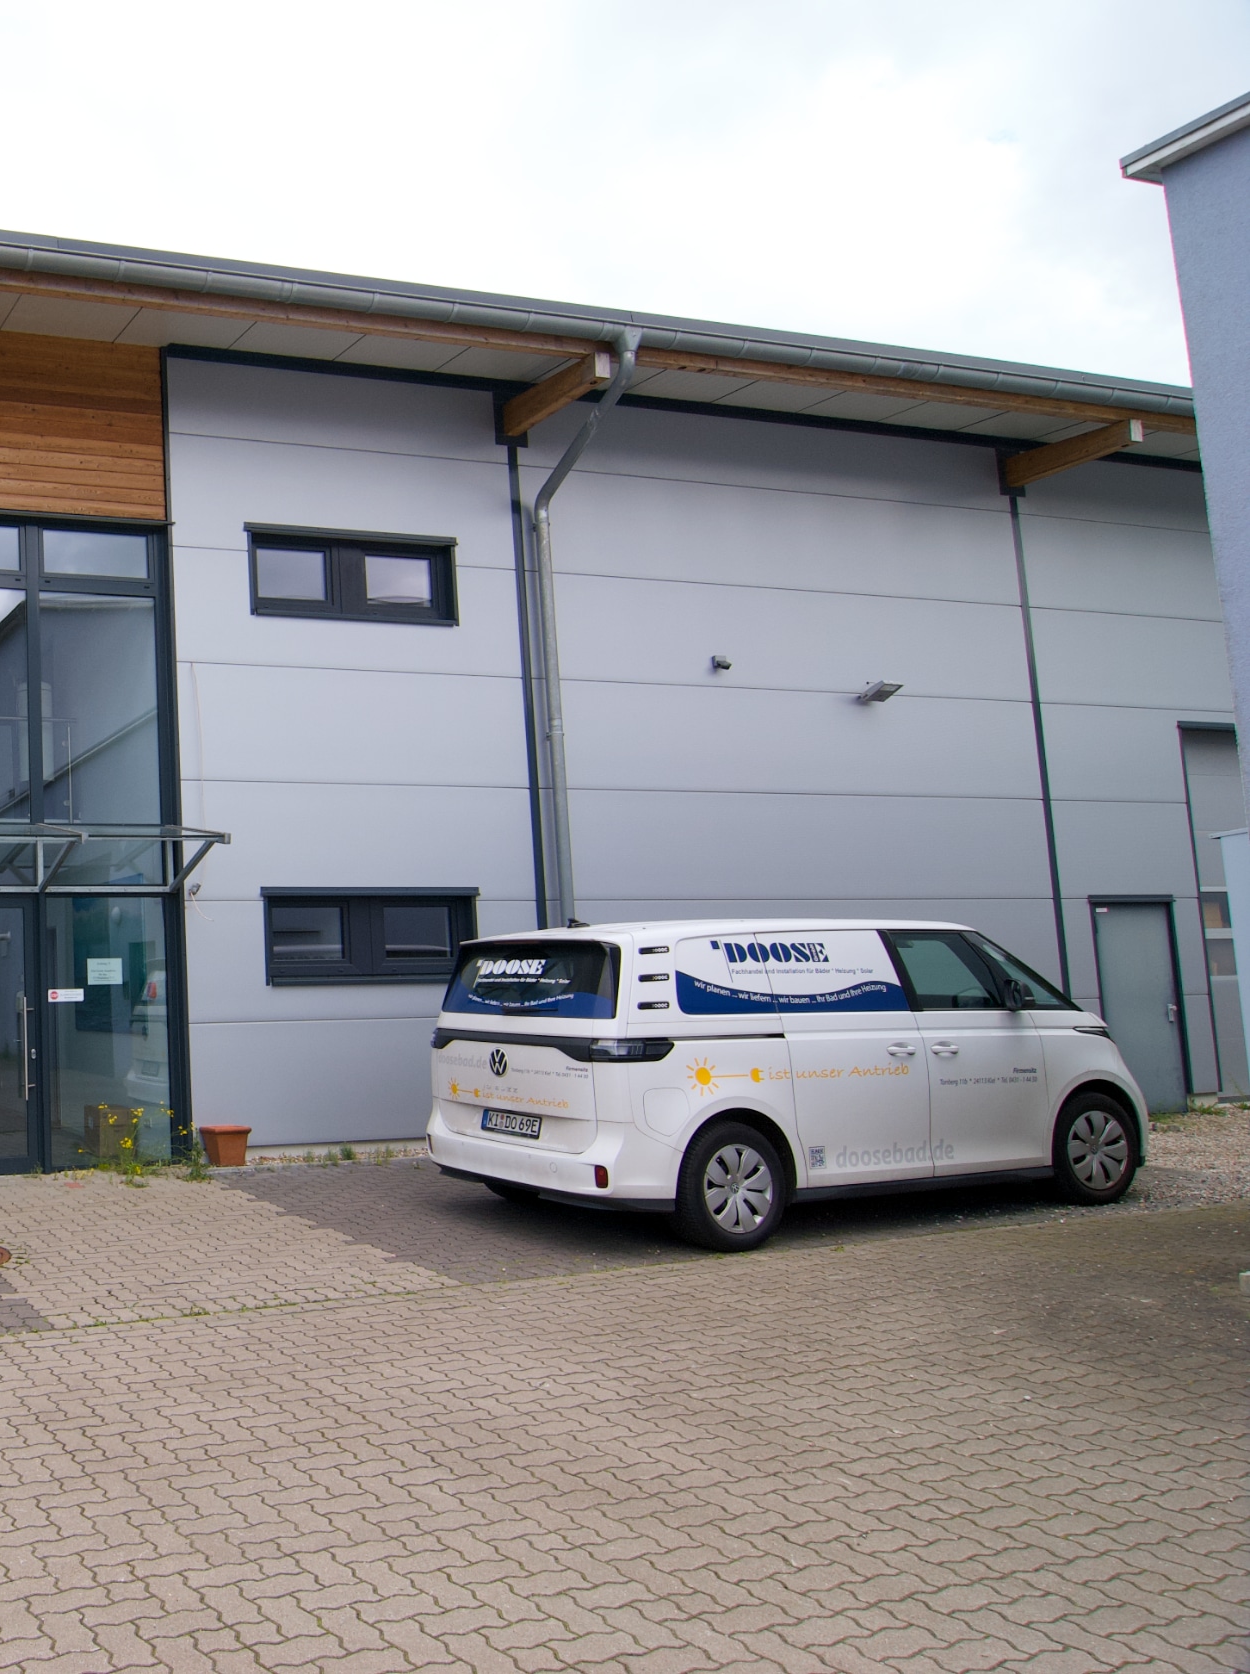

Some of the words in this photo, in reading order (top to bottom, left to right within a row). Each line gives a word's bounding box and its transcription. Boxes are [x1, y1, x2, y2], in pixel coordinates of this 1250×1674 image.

[722, 942, 830, 963] DOOSE
[478, 959, 547, 975] DOOSE
[693, 980, 706, 989] wir
[706, 985, 731, 997] planen
[738, 992, 749, 1000] wir
[749, 992, 772, 1003] liefern
[790, 996, 811, 1004] bauen
[816, 995, 825, 1003] Ihr
[825, 993, 838, 1002] Bad
[838, 991, 850, 1000] und
[850, 988, 862, 997] Ihre
[860, 983, 887, 993] Heizung
[768, 1066, 791, 1080] ist
[795, 1067, 845, 1079] unser
[848, 1062, 910, 1078] Antrieb
[482, 1089, 494, 1099] ist
[496, 1094, 525, 1103] unser
[525, 1097, 569, 1109] Antrieb
[487, 1112, 499, 1127] KI
[504, 1115, 518, 1130] DO
[518, 1117, 539, 1133] 69E
[835, 1138, 955, 1169] doosebad.de
